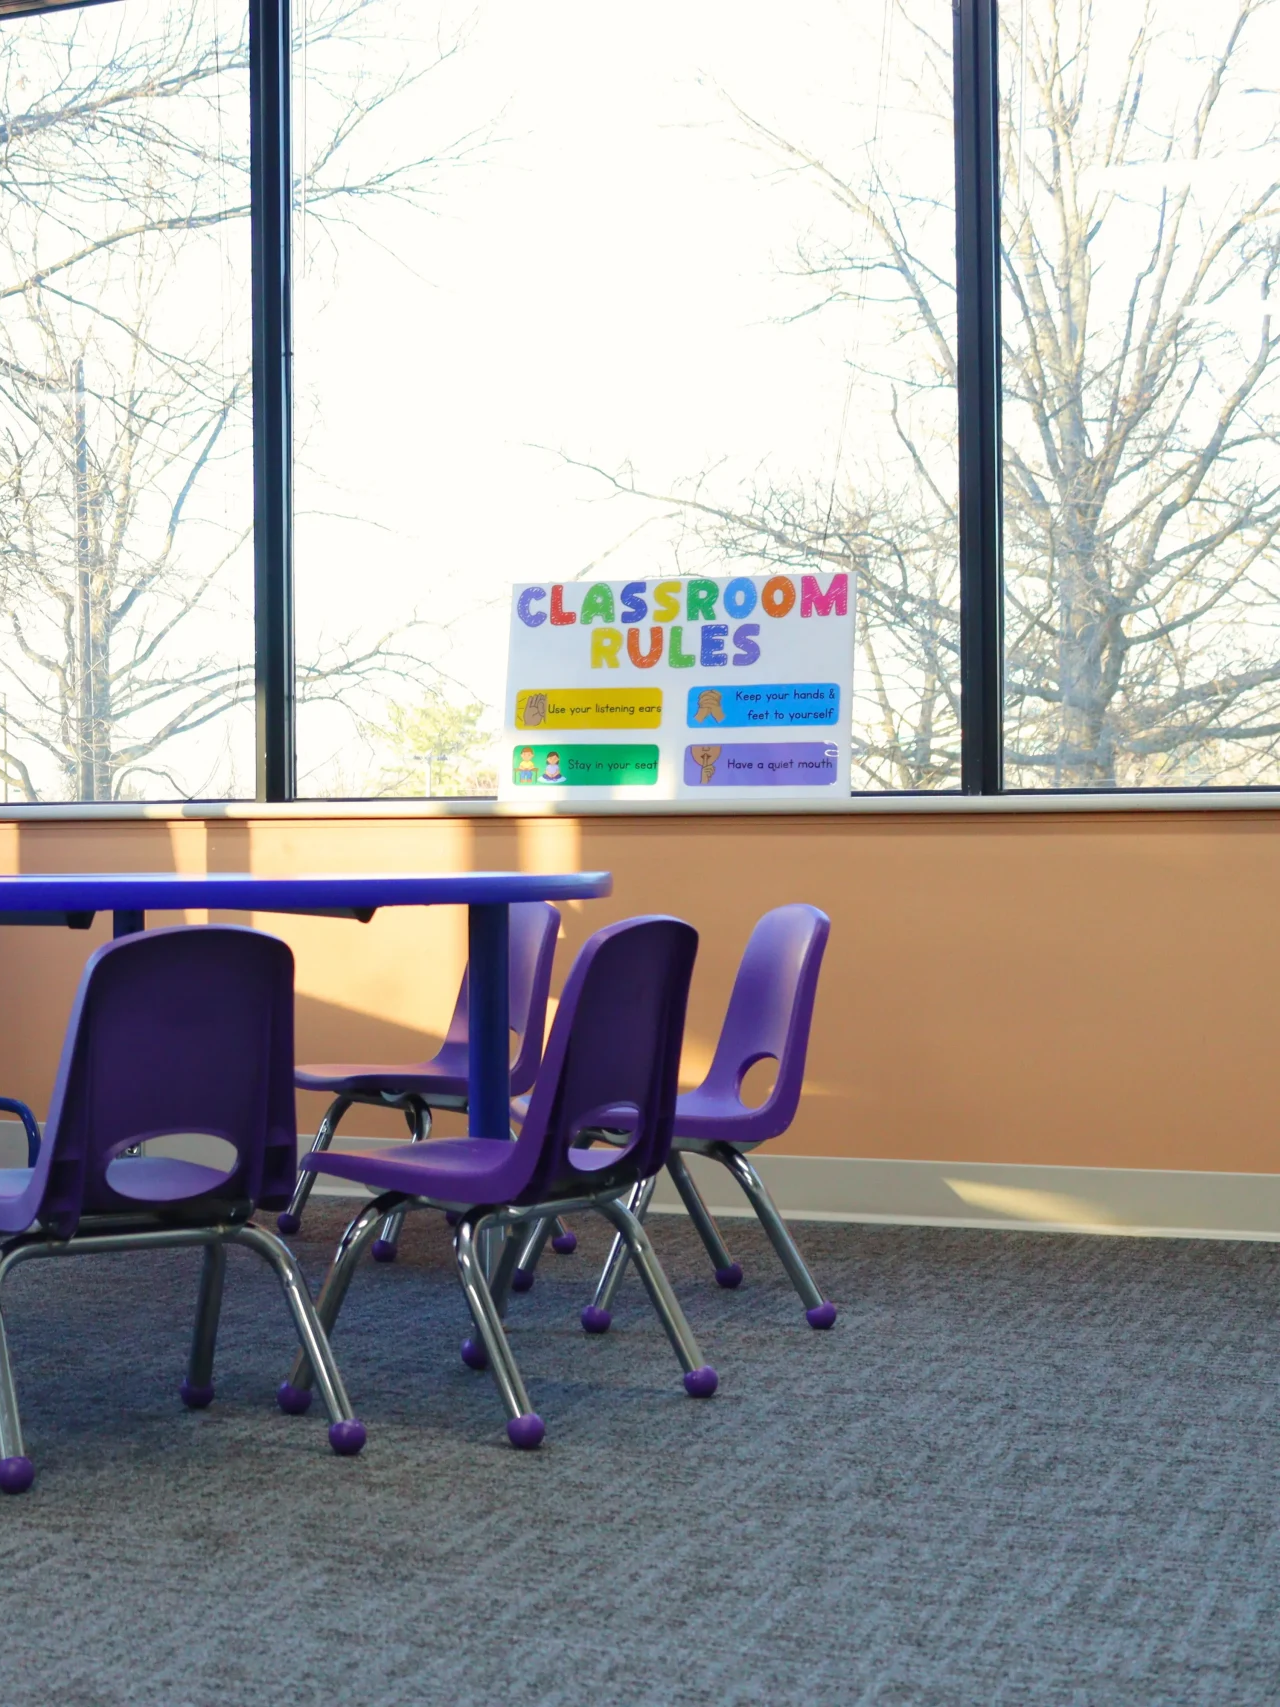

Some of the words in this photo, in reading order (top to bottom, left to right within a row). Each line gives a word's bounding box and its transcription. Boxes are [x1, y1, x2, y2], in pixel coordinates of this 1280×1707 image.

[517, 573, 849, 628] CLASSROOM
[590, 623, 761, 669] RULES
[736, 690, 762, 702] Keep
[766, 691, 789, 703] your
[793, 688, 825, 700] hands
[828, 688, 836, 699] &
[548, 704, 566, 714] Use
[570, 705, 592, 716] your
[595, 703, 635, 715] listening
[638, 704, 662, 713] ears
[747, 709, 770, 720] feet
[774, 710, 785, 720] to
[789, 708, 835, 721] yourself
[568, 759, 591, 771] Stay
[595, 760, 604, 770] in
[607, 762, 630, 772] your
[634, 760, 658, 770] seat
[727, 758, 753, 769] Have
[767, 759, 794, 772] quiet
[797, 758, 833, 769] mouth
